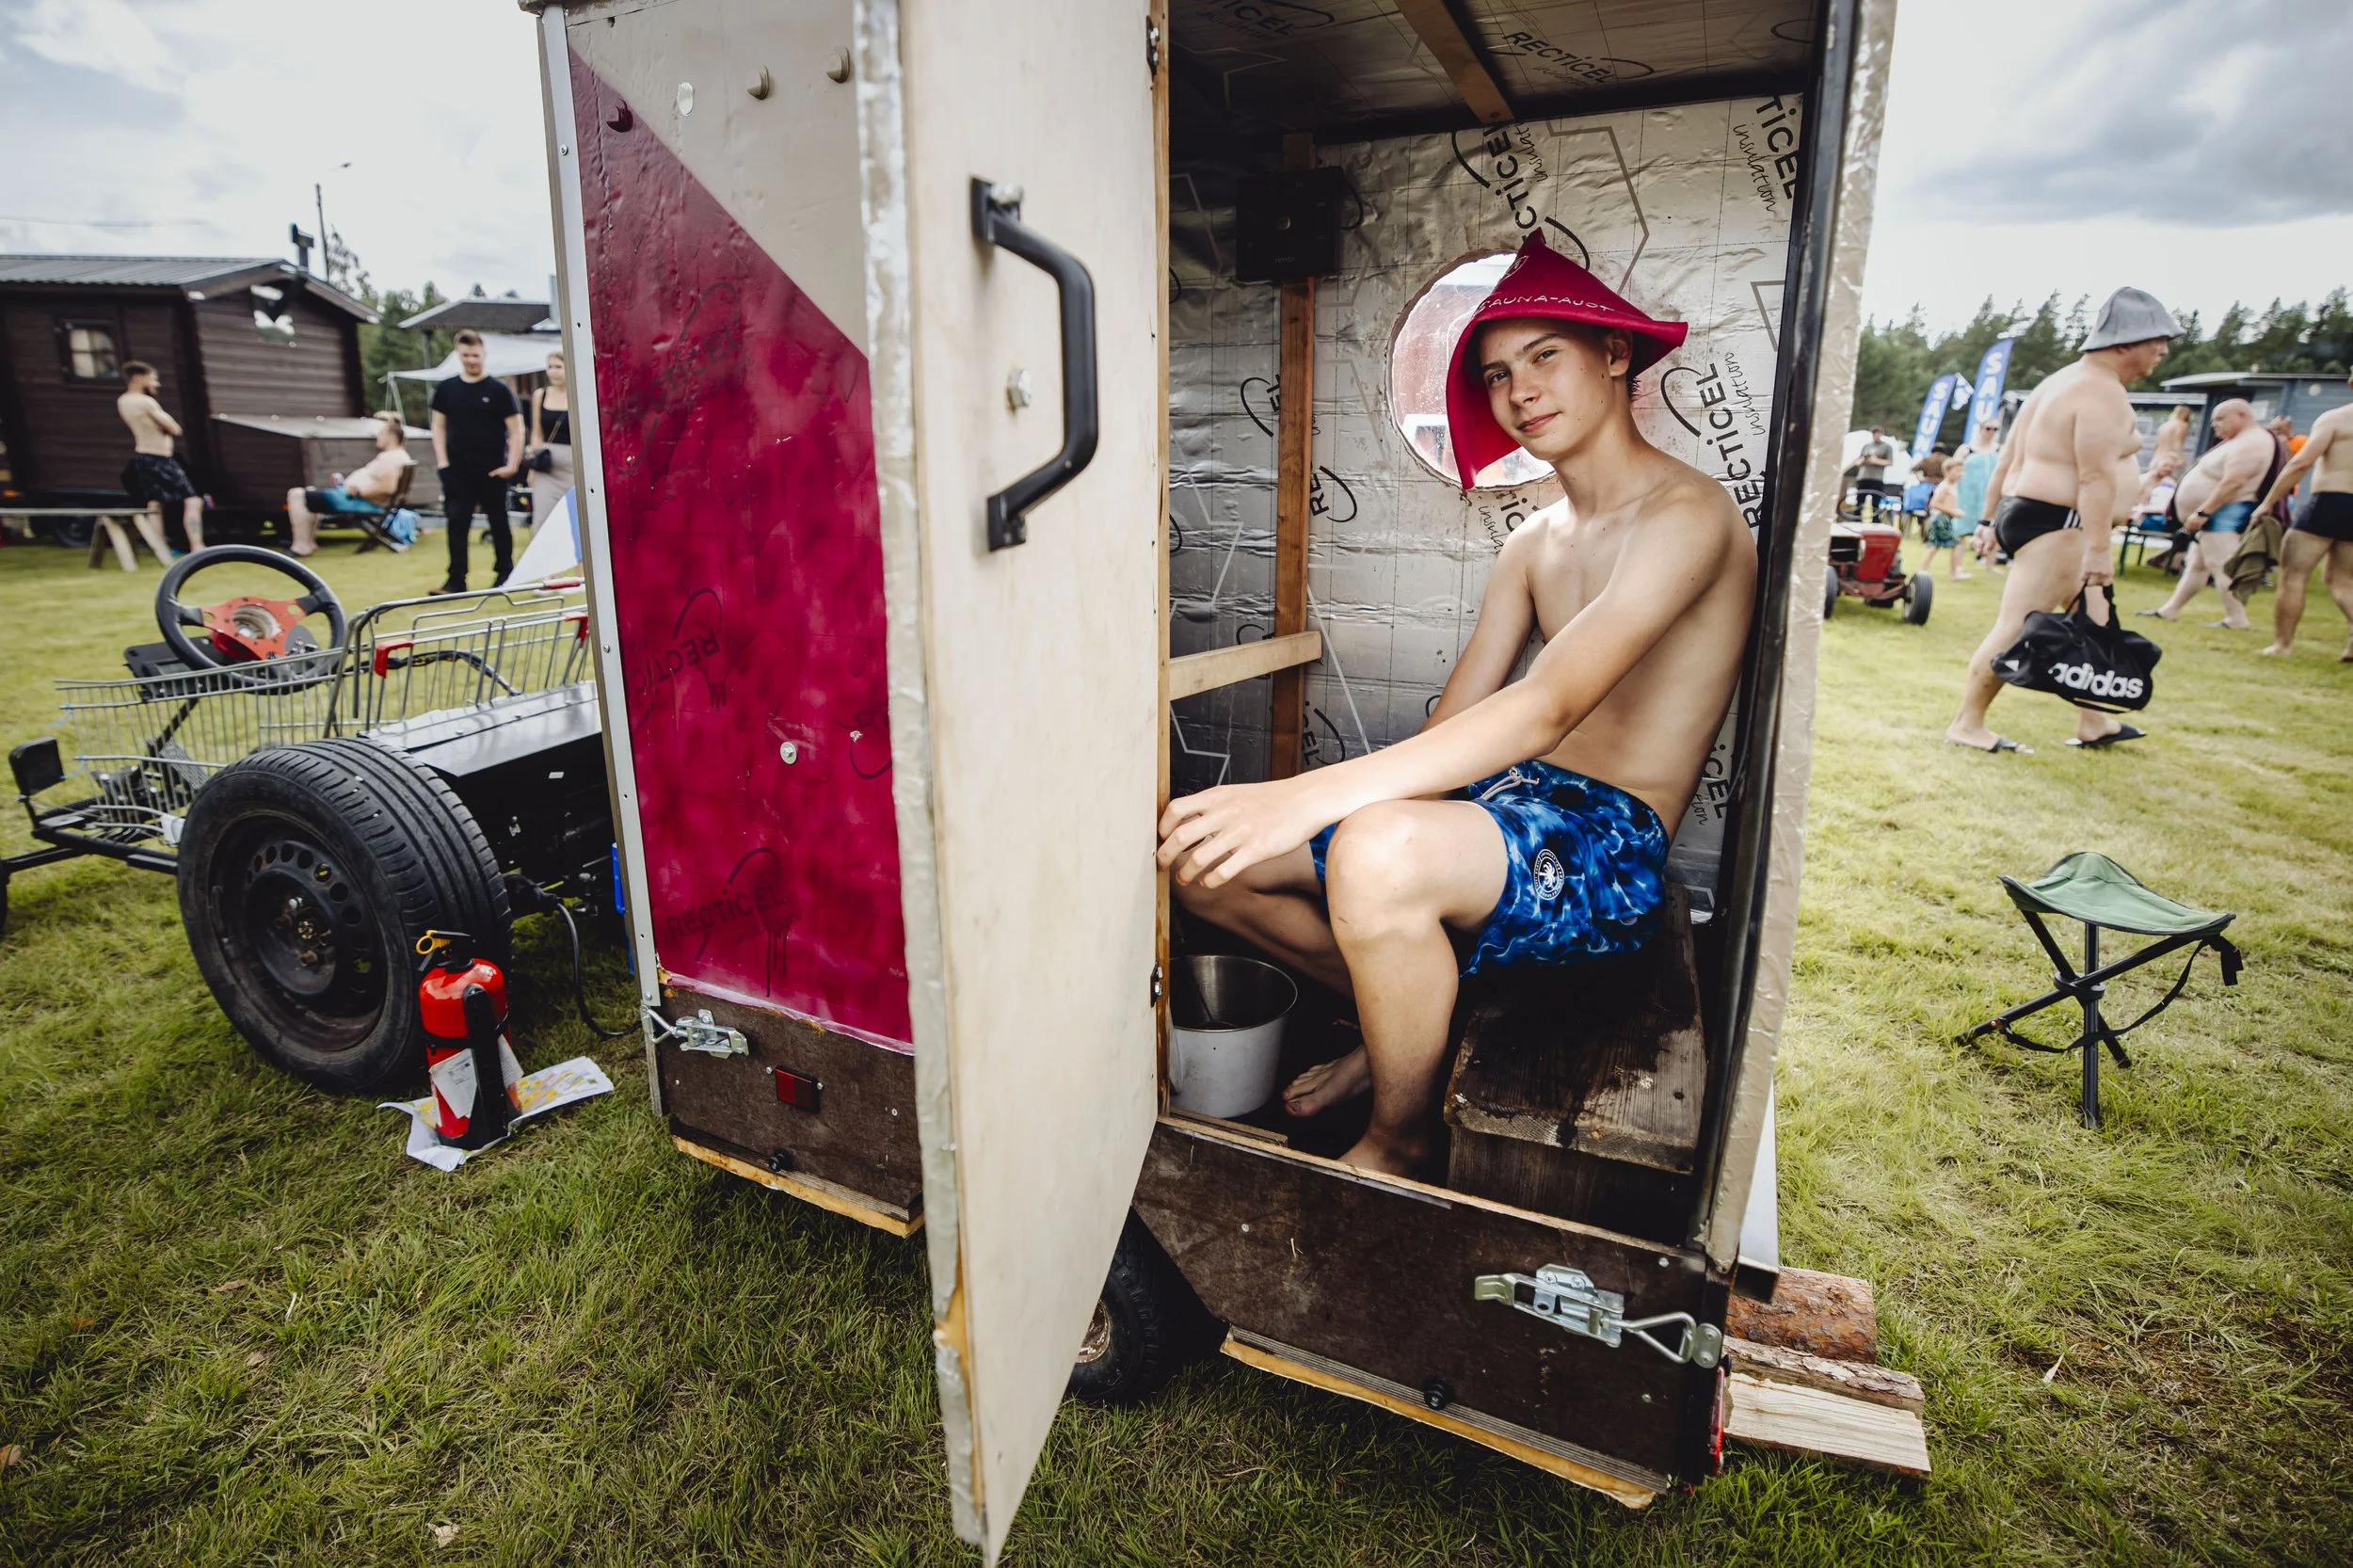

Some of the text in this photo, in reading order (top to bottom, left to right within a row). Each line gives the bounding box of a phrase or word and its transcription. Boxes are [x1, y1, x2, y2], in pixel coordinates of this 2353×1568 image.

[1733, 123, 1778, 212] insulation
[1725, 352, 1766, 436] insulation
[2047, 662, 2144, 698] adidas
